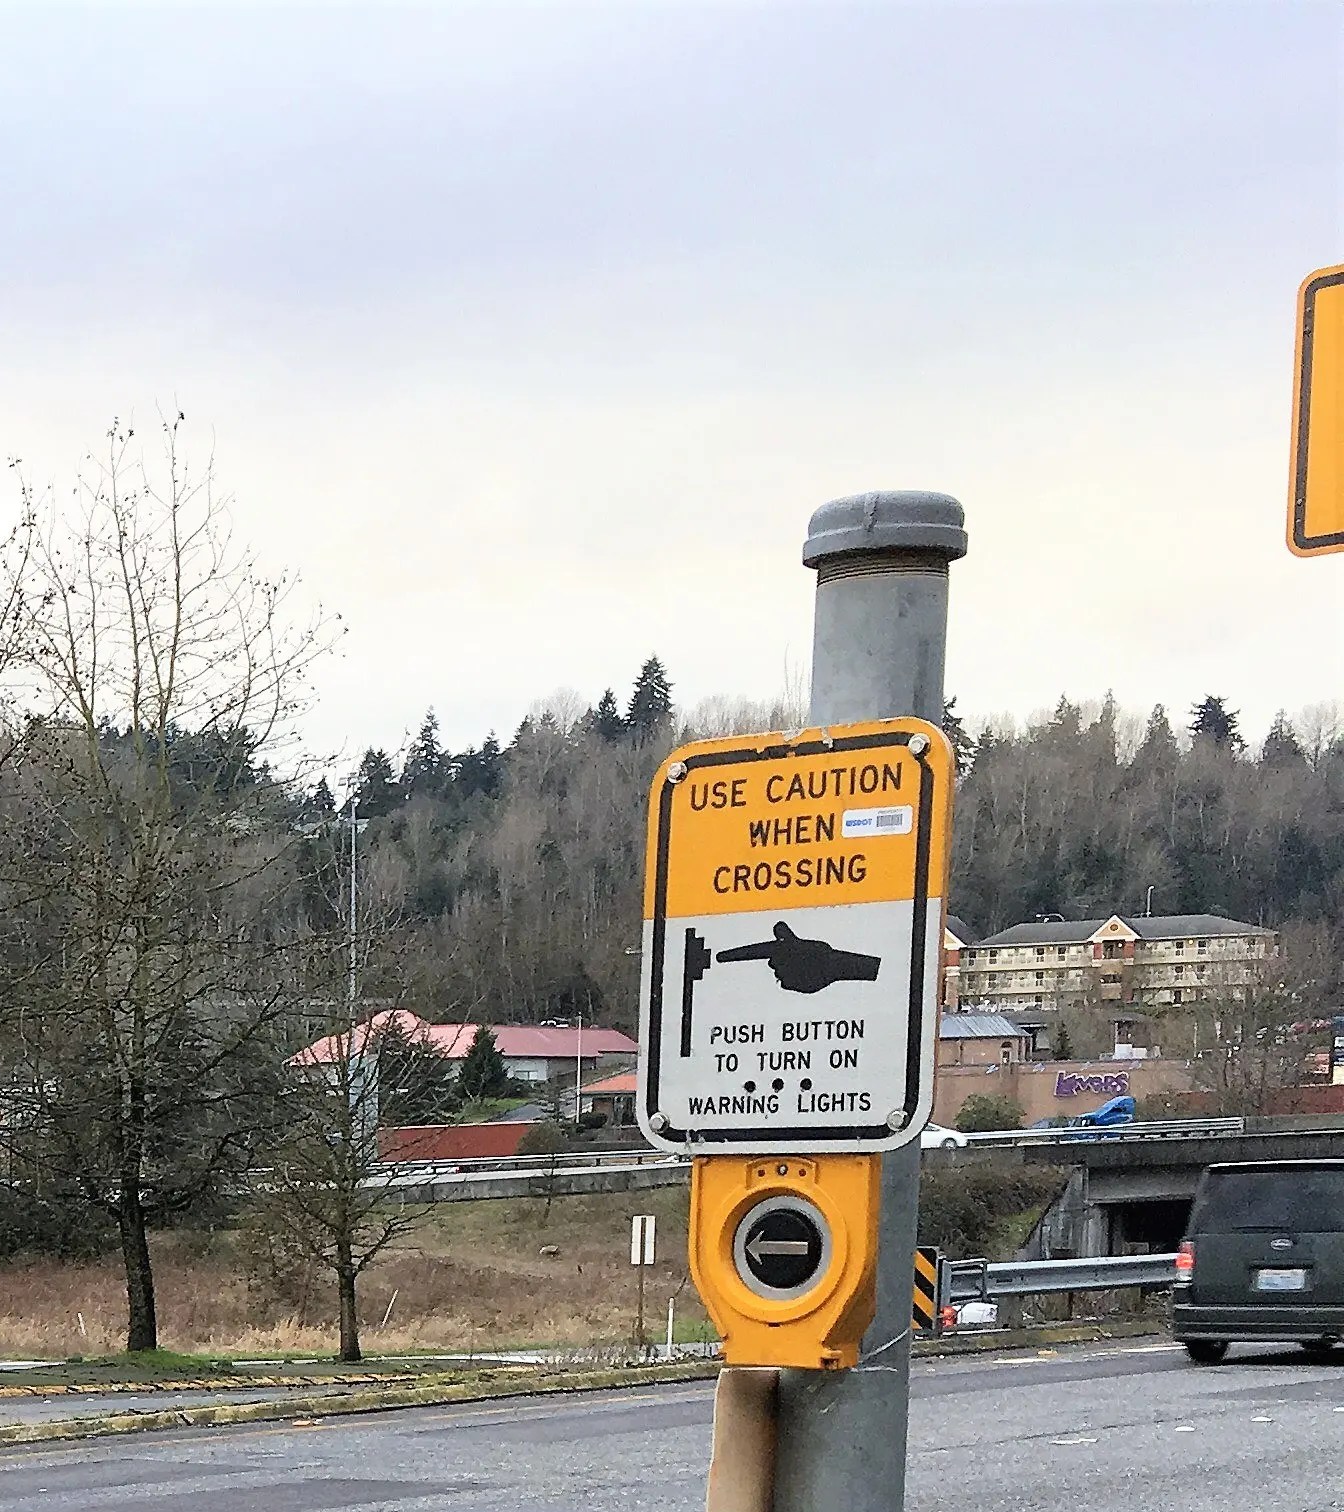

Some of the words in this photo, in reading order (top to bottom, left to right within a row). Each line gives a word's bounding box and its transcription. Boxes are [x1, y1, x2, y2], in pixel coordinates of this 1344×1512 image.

[690, 778, 748, 811] USE
[765, 762, 903, 804] CAUTION
[749, 813, 835, 848] WHEN
[713, 854, 868, 894] CROSSING
[710, 1024, 765, 1045] PUSH
[781, 1019, 865, 1042] BUTTON
[714, 1053, 739, 1073] TO
[757, 1050, 811, 1072] TURN
[829, 1049, 859, 1069] ON
[688, 1094, 780, 1116] WARNING
[797, 1092, 872, 1113] LIGHTS
